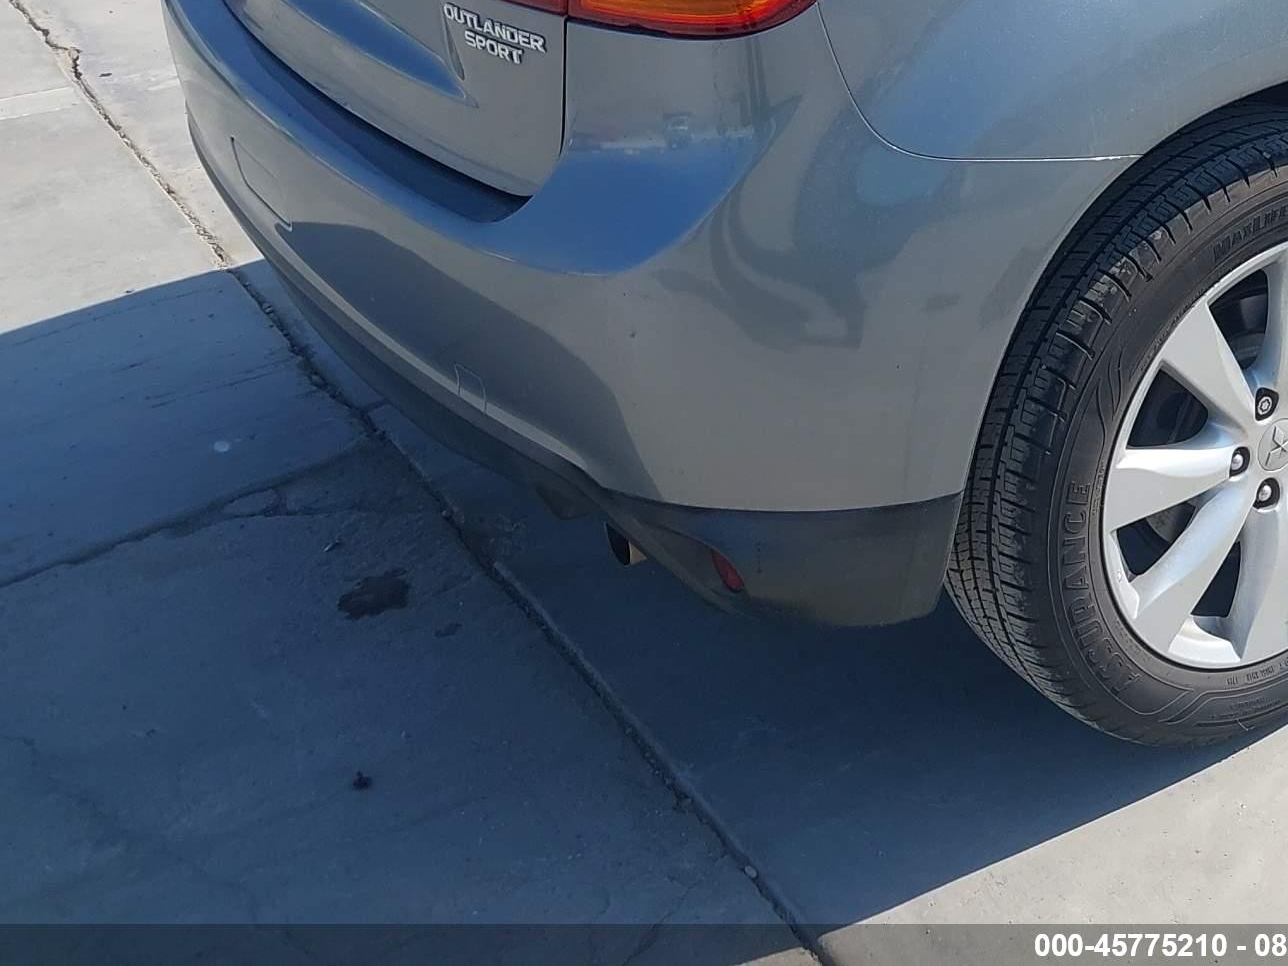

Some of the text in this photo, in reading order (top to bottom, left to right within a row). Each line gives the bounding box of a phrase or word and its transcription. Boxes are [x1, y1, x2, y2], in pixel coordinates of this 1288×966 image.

[443, 2, 547, 53] OUTLANDER
[464, 30, 523, 64] SPORT
[1063, 481, 1142, 695] ASSURANCE
